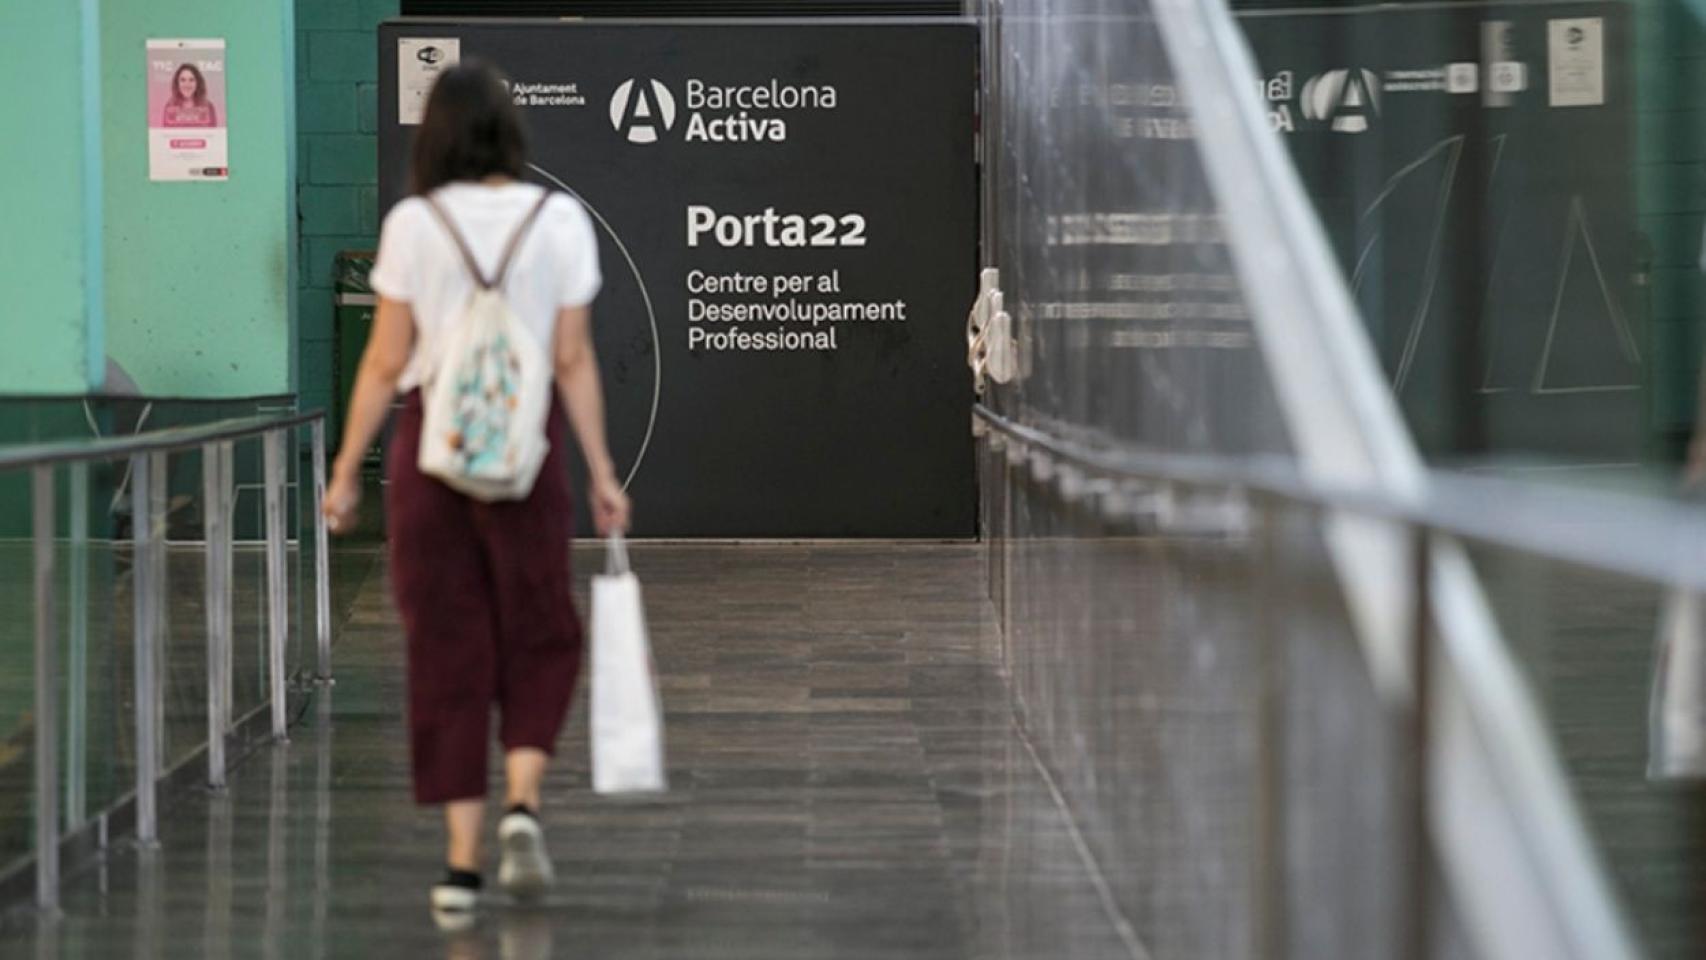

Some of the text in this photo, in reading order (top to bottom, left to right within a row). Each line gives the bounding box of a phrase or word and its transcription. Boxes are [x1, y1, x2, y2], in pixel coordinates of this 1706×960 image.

[512, 83, 577, 95] Ajuntament
[513, 94, 586, 106] de Barcelona
[686, 78, 837, 109] Barcelona
[685, 111, 787, 142] Activa
[686, 205, 868, 248] Porta22
[686, 269, 841, 299] Centre per al
[687, 298, 907, 326] Desenvolupament
[687, 326, 838, 351] Professional
